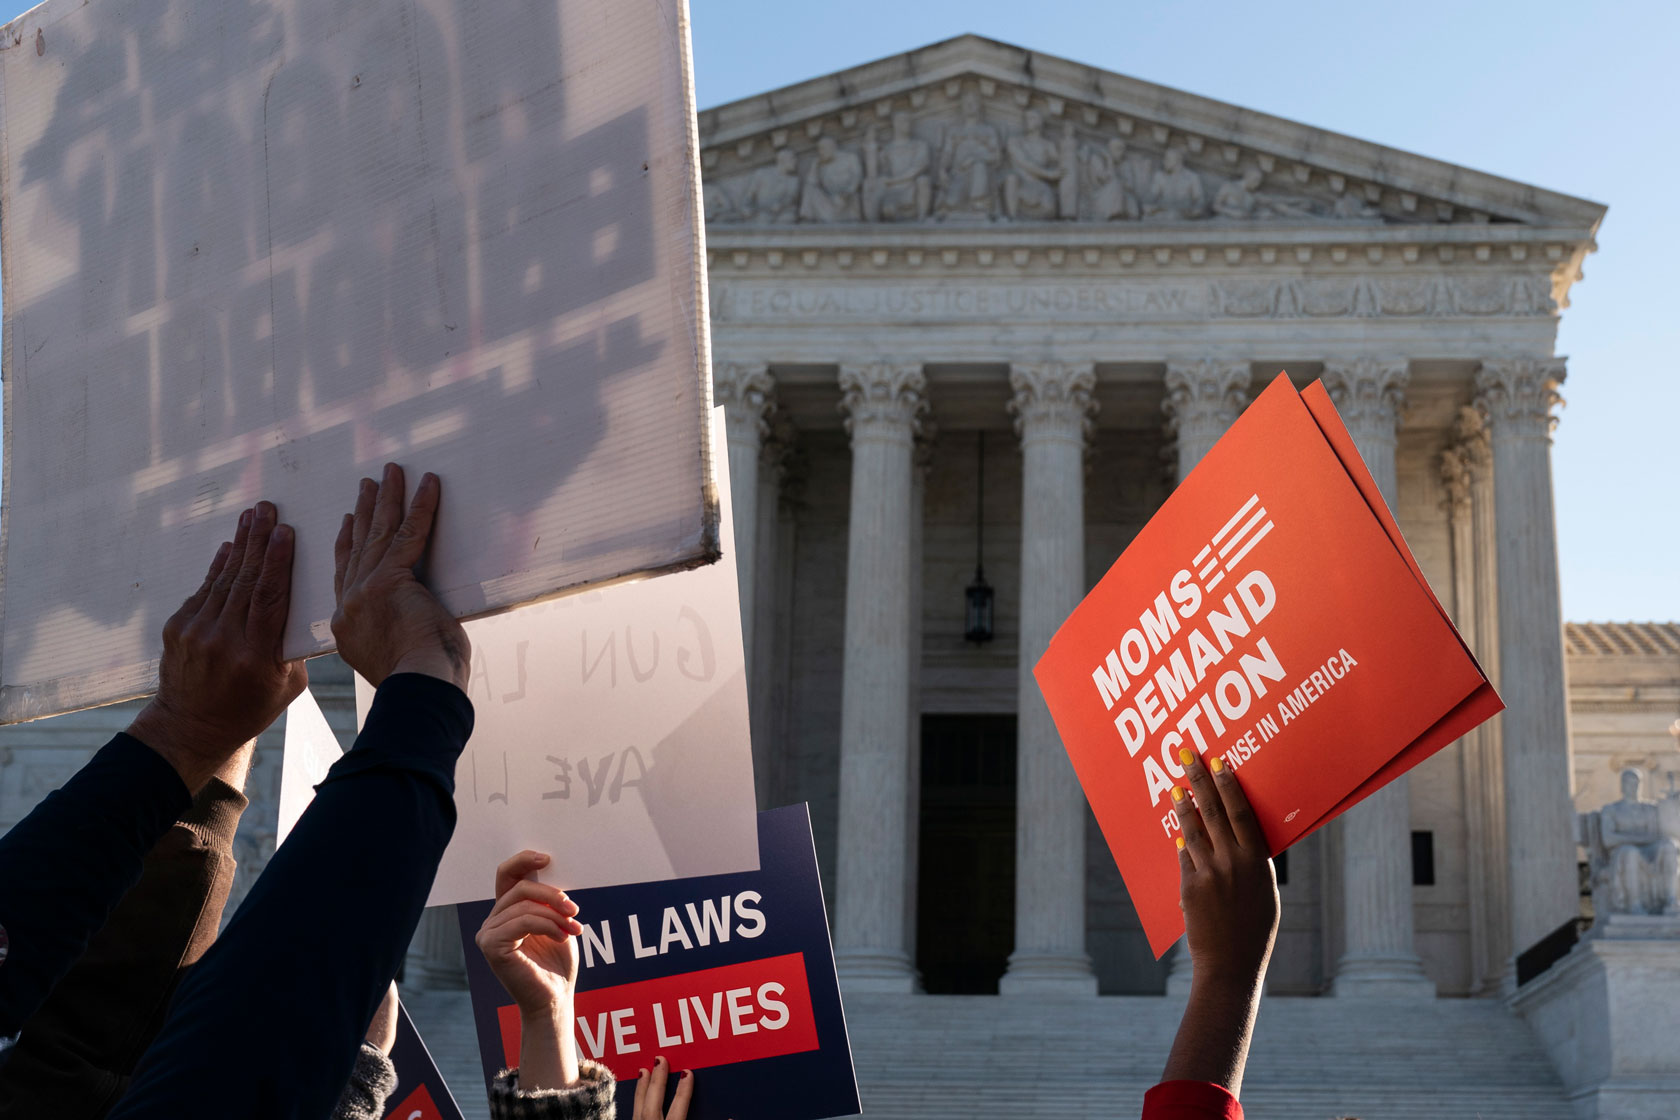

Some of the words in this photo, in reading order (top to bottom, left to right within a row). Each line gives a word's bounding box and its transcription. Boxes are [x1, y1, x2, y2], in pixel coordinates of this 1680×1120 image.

[751, 288, 853, 314] EQUAL
[865, 286, 990, 314] JUSTICE
[1005, 286, 1113, 313] UNDER
[1124, 286, 1188, 313] LAW
[1092, 570, 1202, 711] MOMS
[1114, 570, 1277, 758] DEMAND
[1142, 636, 1287, 808] ACTION
[1161, 809, 1181, 838] FO
[1255, 713, 1280, 743] IN
[1277, 648, 1358, 726] AMERICA
[628, 890, 767, 959] LAWS
[652, 981, 790, 1048] LIVES
